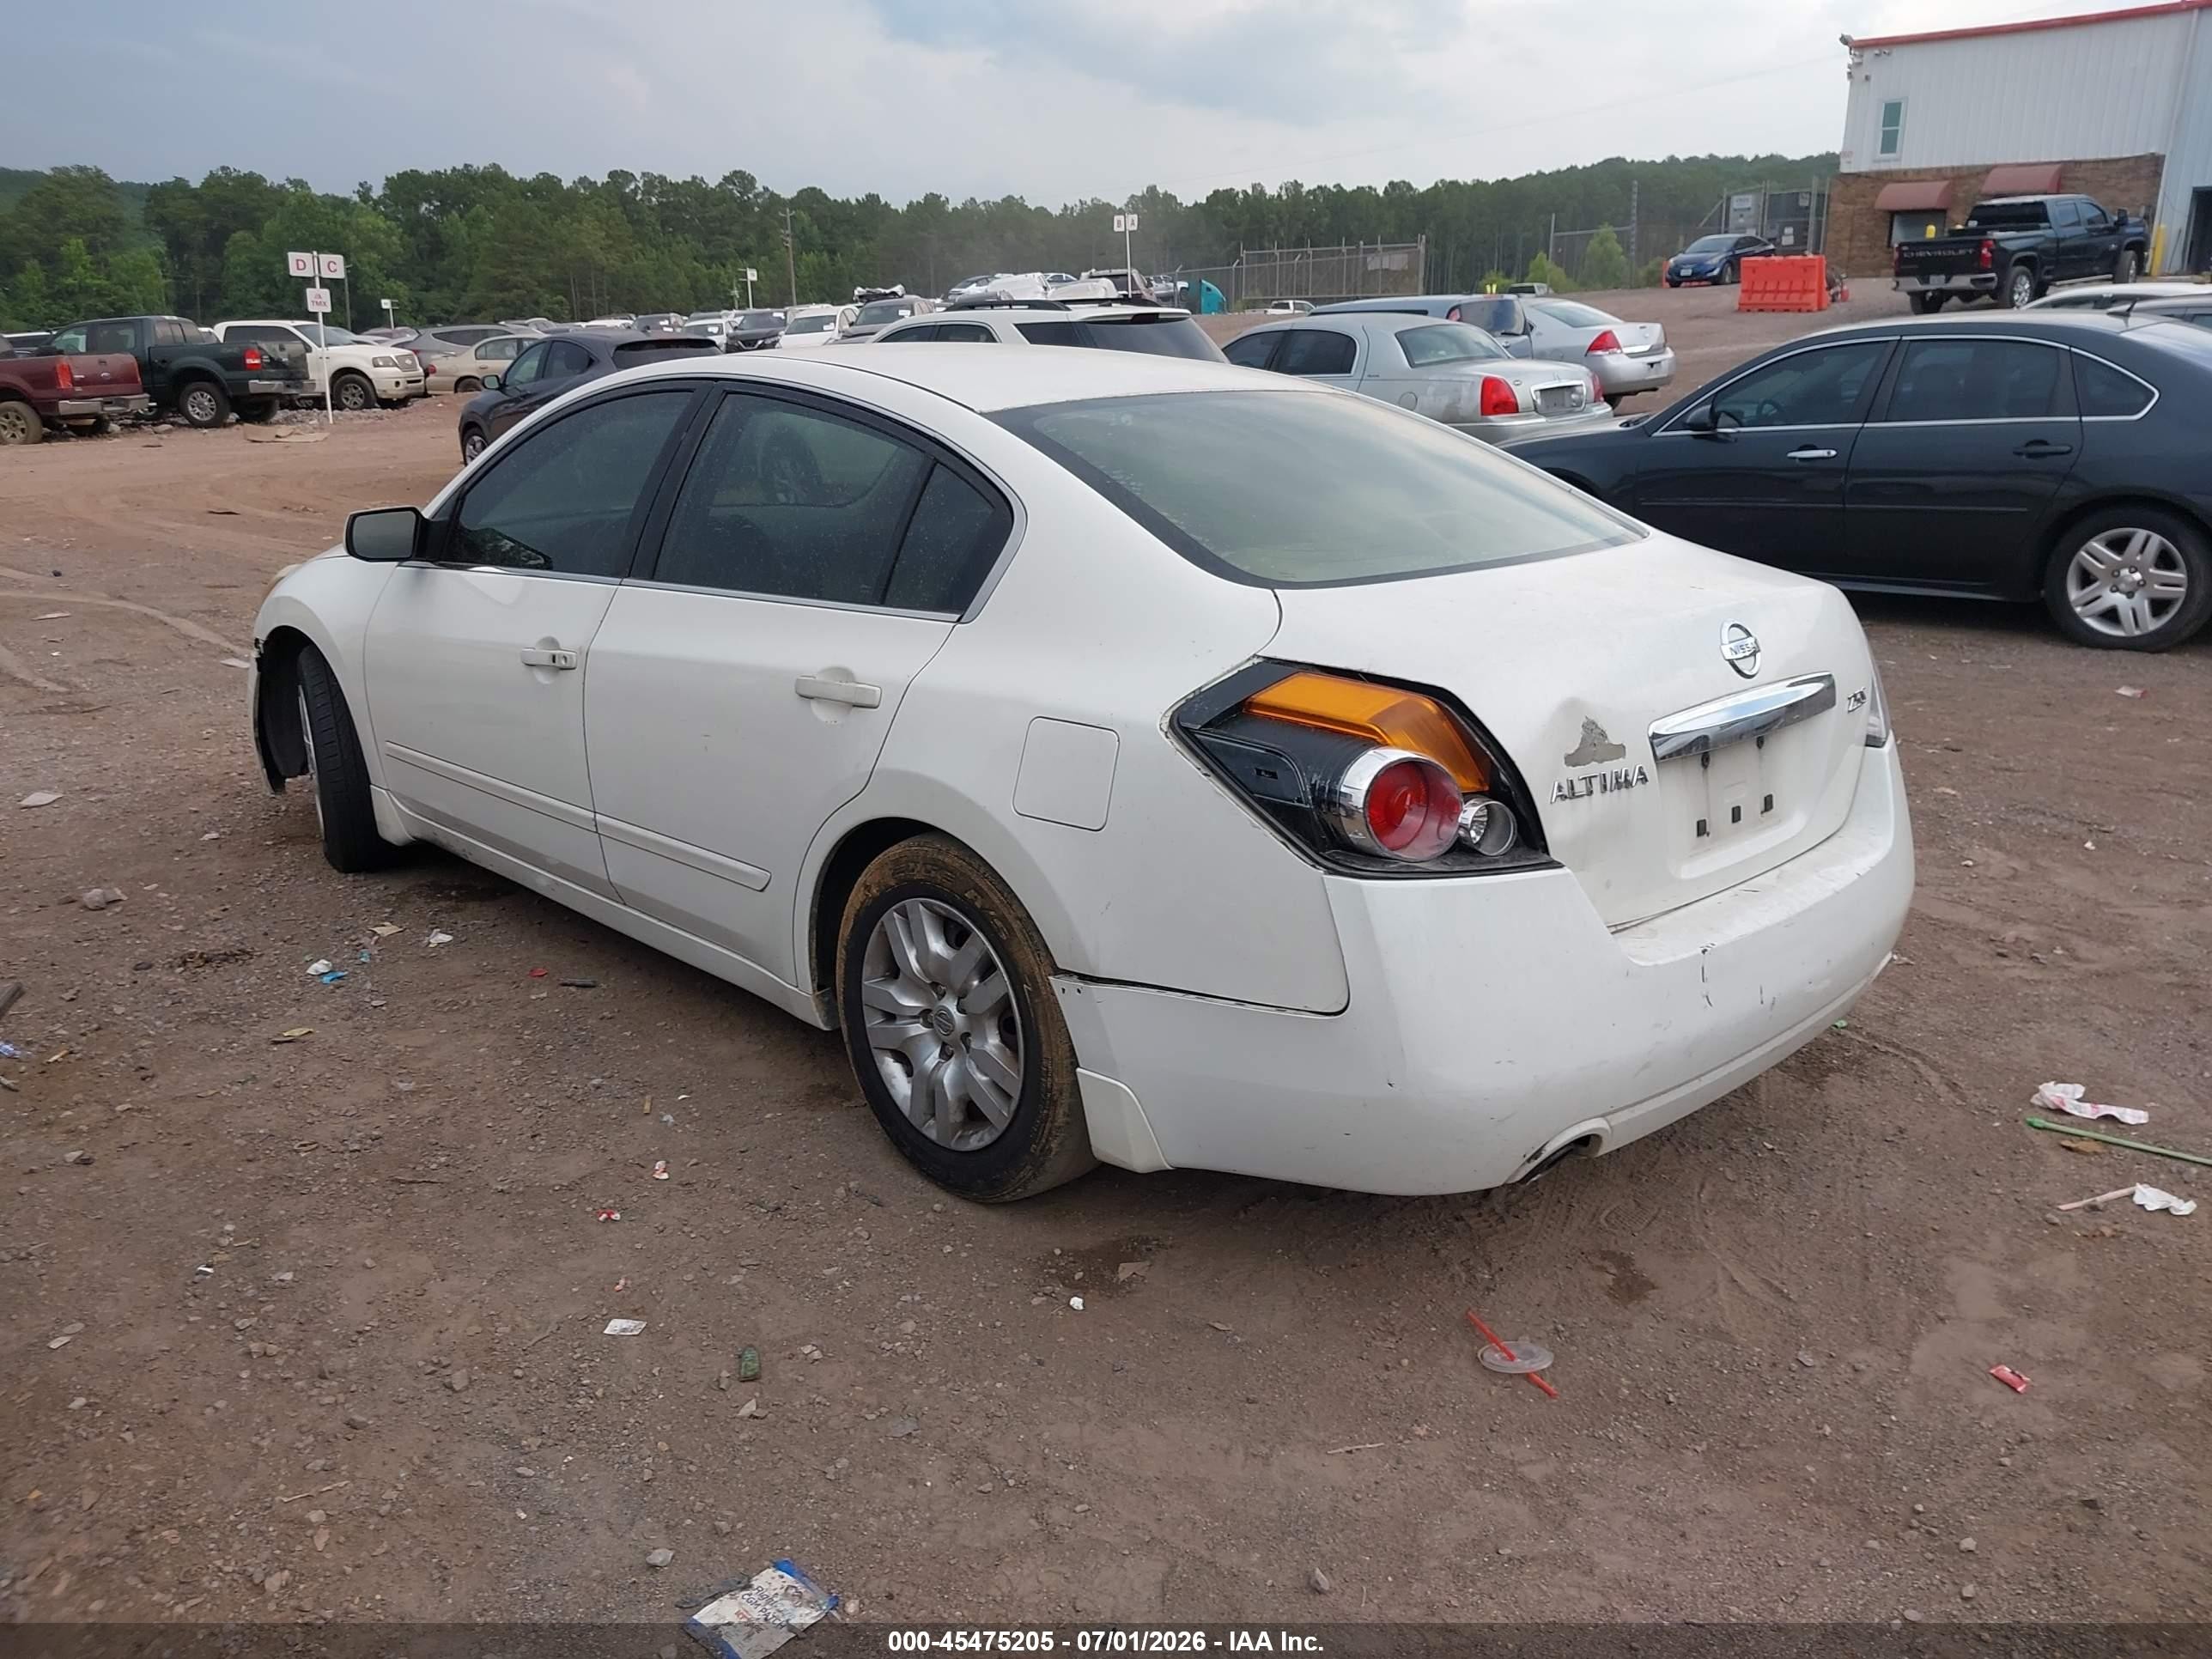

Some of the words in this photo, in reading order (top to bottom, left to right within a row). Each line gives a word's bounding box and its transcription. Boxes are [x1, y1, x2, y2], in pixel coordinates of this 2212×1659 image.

[295, 259, 307, 270] D
[327, 261, 337, 272] C
[1550, 764, 1649, 804] ALTIMA
